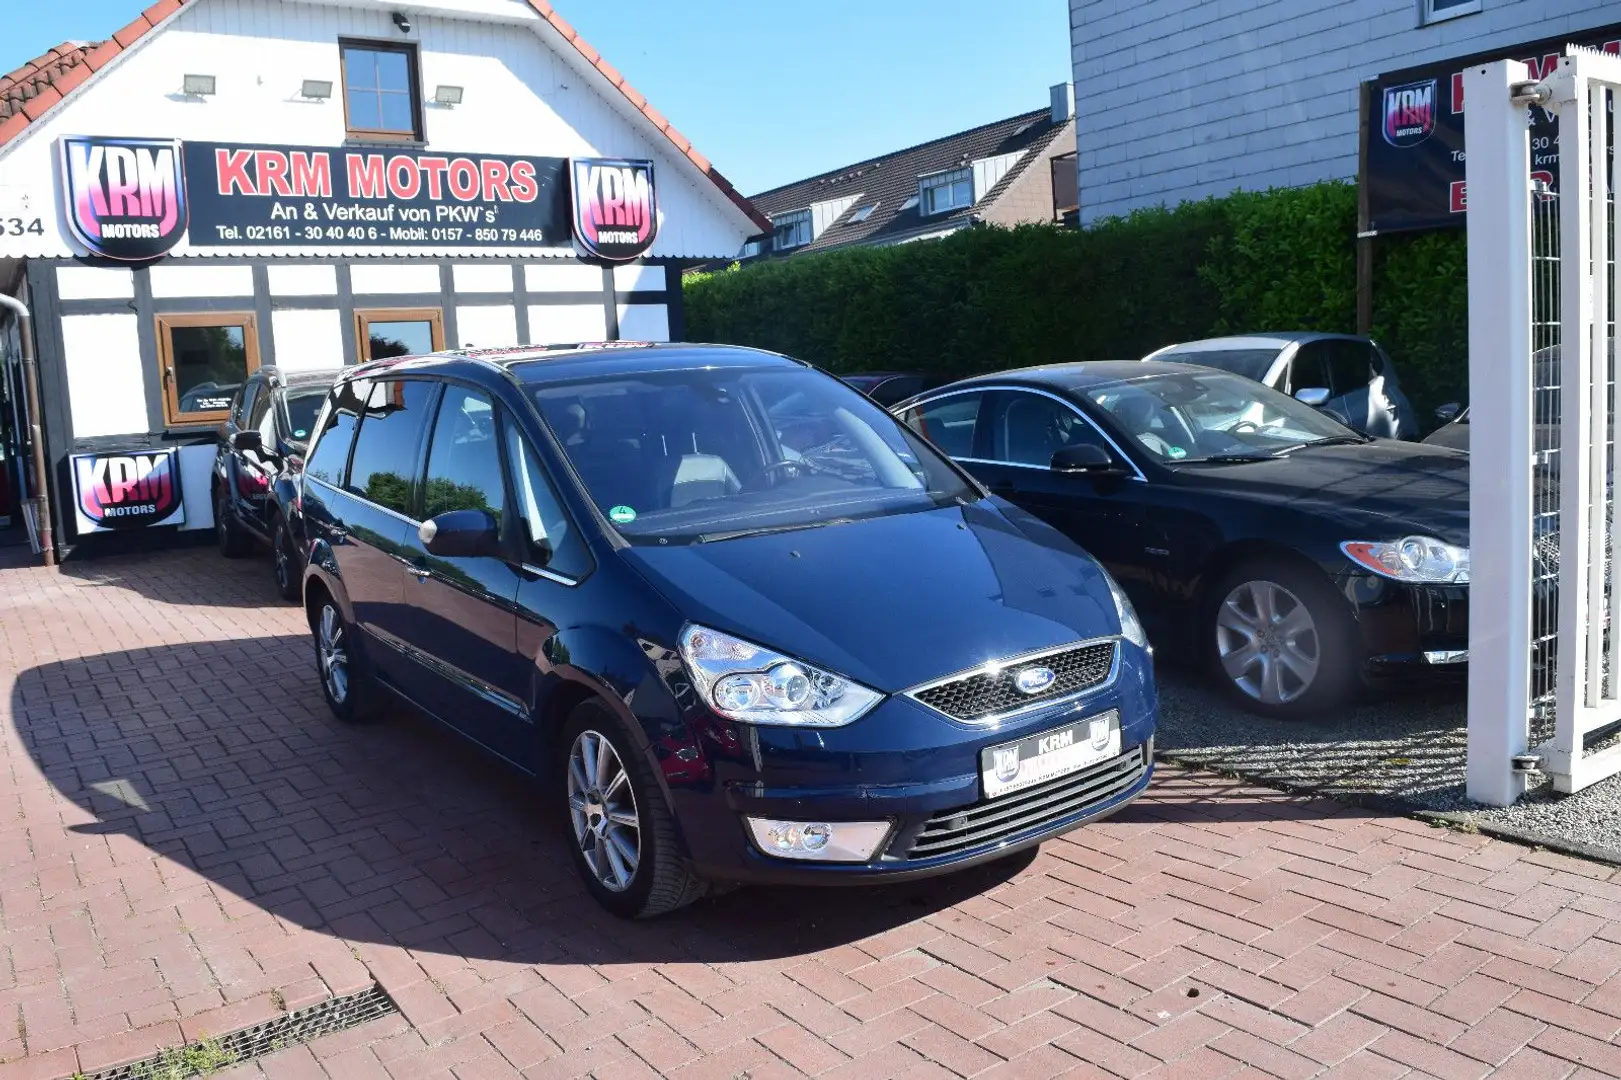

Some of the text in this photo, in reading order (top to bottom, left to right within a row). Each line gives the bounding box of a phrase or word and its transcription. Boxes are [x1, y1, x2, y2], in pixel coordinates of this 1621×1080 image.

[1387, 86, 1432, 137] KRM
[1396, 127, 1423, 137] MOTORS
[215, 148, 539, 202] KRM MOTORS
[69, 145, 177, 236] KRM
[271, 202, 298, 220] An
[303, 202, 319, 220] &
[323, 203, 395, 222] Verkauf
[399, 207, 431, 222] von
[578, 165, 652, 244] KRM
[102, 223, 160, 239] MOTORS
[216, 225, 243, 240] Tel.
[246, 225, 290, 240] 02161
[305, 226, 323, 240] 30
[326, 227, 344, 240] 40
[347, 227, 365, 240] 40
[368, 228, 378, 240] 6
[389, 227, 428, 241] Mobil:
[431, 228, 463, 241] 0157
[475, 228, 499, 241] 850
[501, 229, 517, 241] 79
[519, 229, 543, 242] 446
[598, 230, 639, 244] MOTORS
[78, 454, 171, 518] KRM
[104, 504, 156, 518] MOTORS
[1038, 729, 1073, 755] KRM
